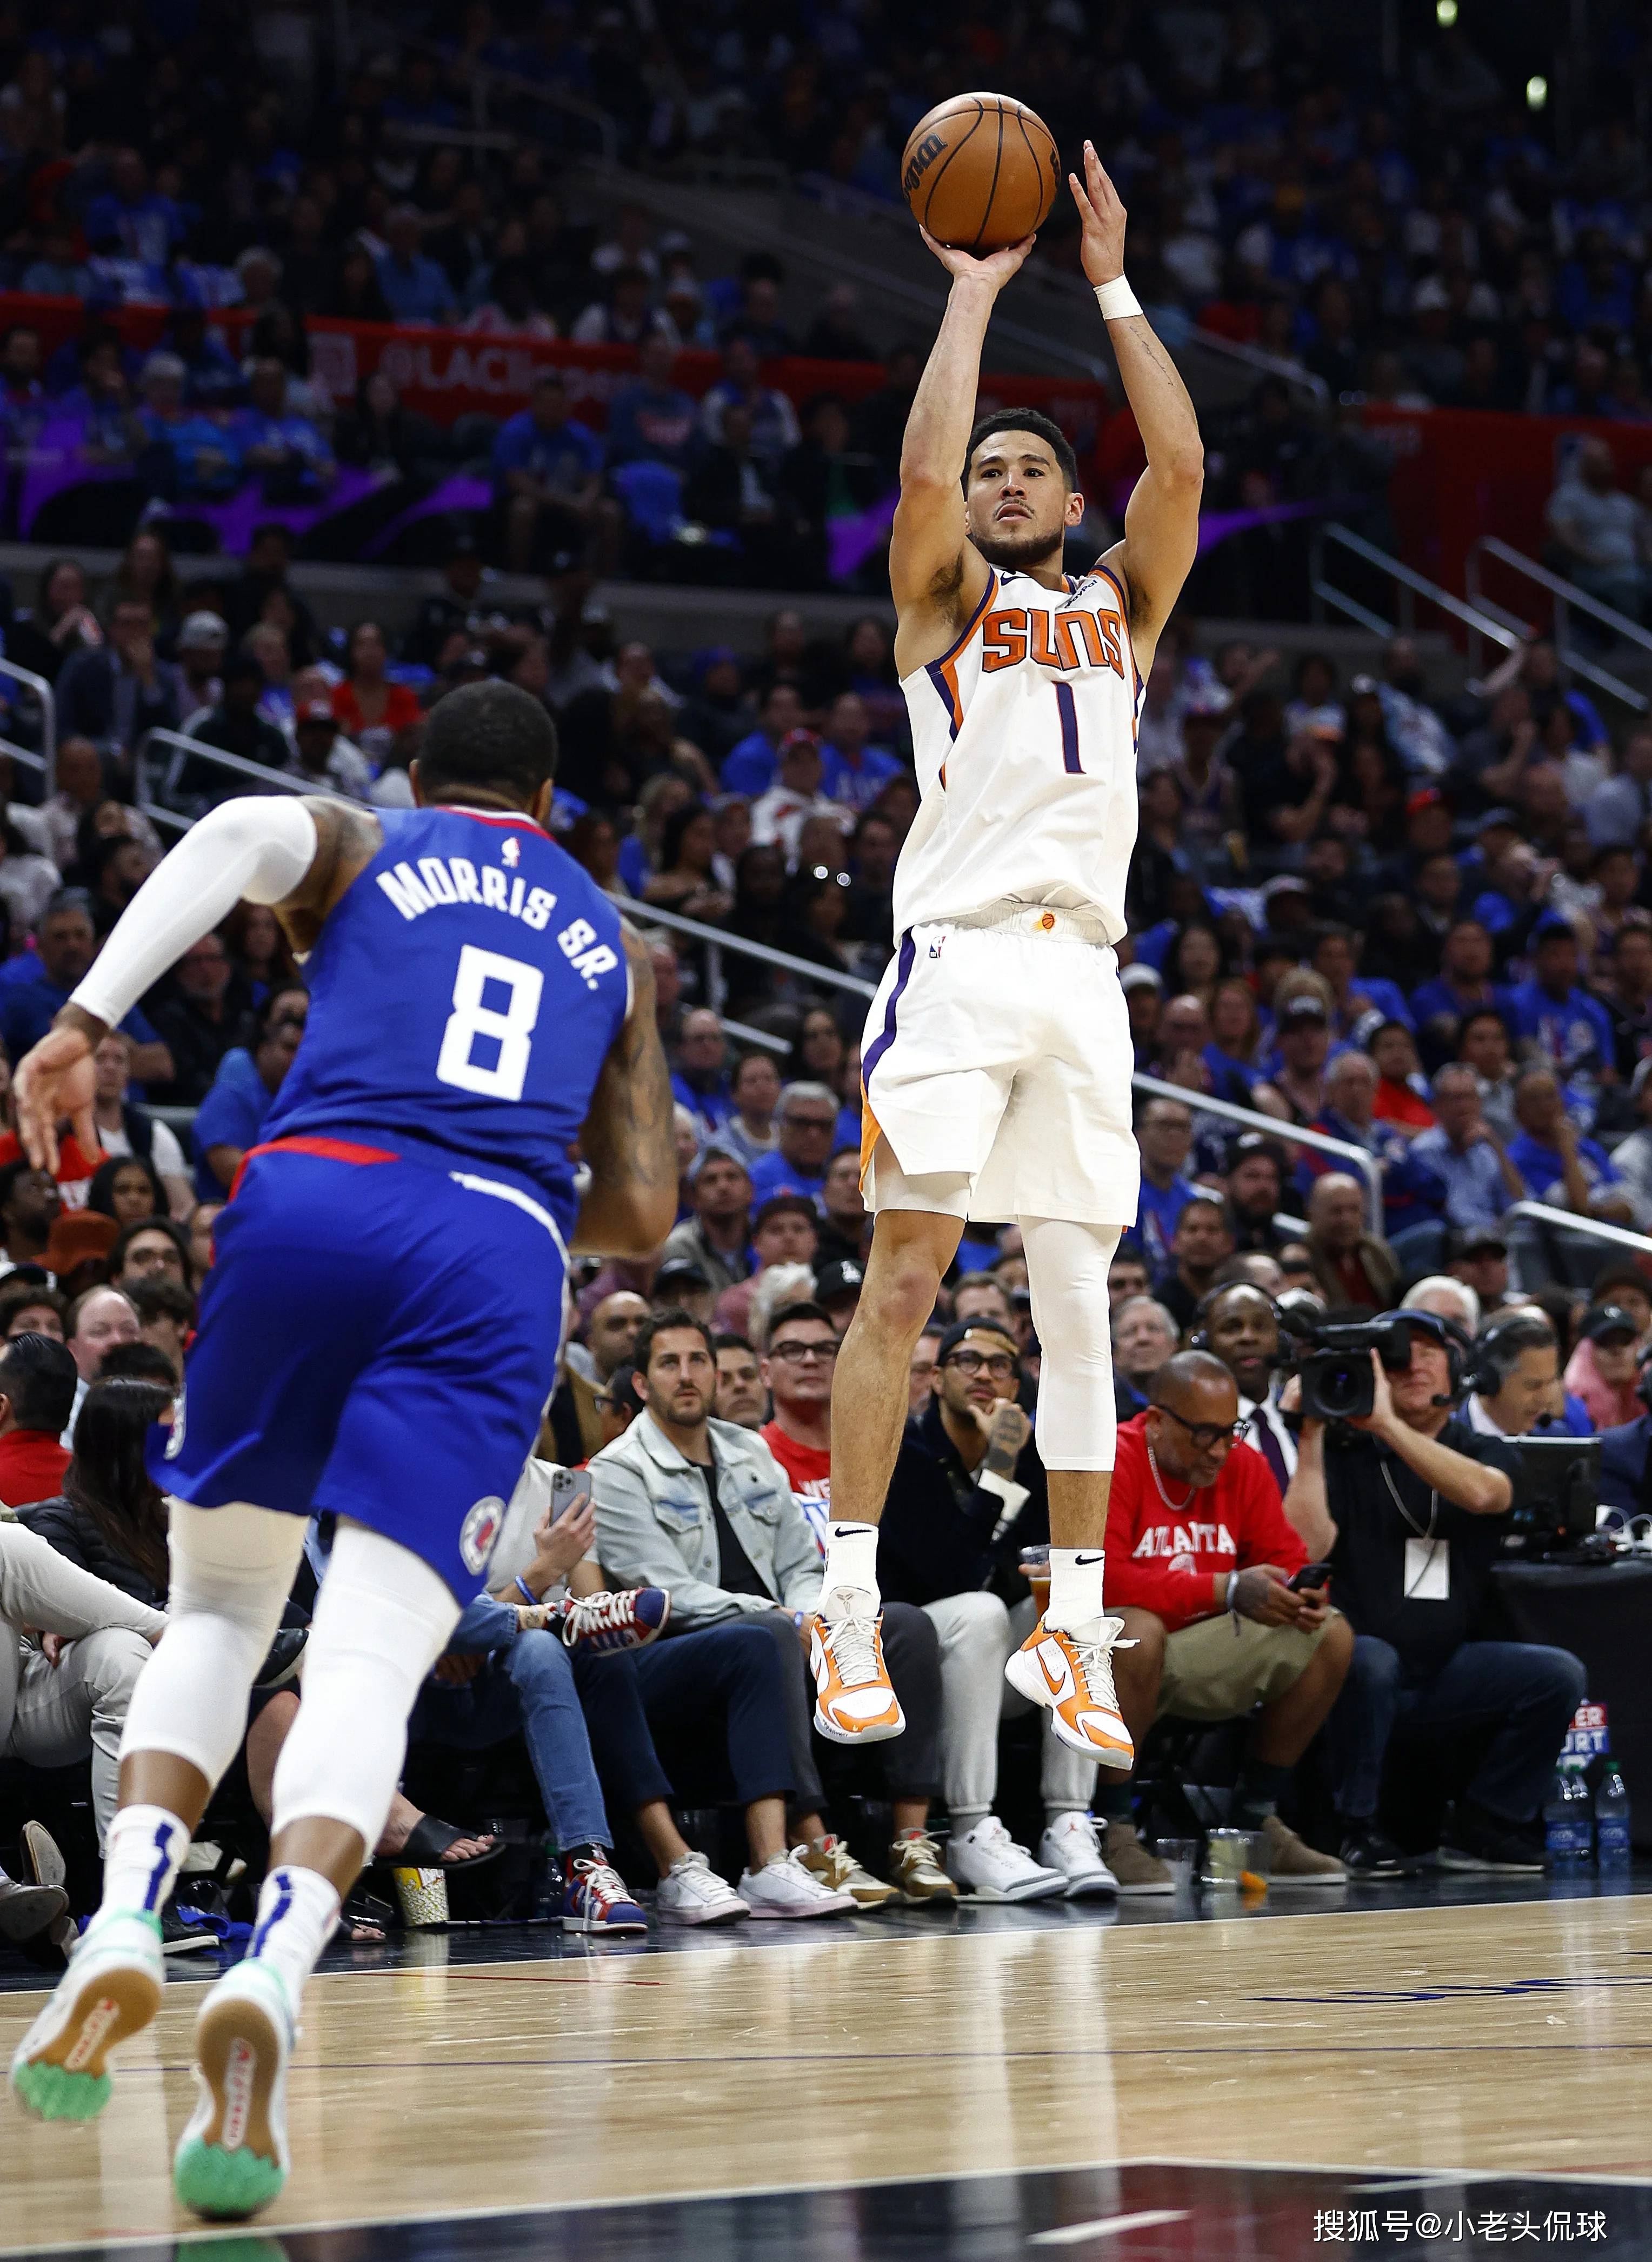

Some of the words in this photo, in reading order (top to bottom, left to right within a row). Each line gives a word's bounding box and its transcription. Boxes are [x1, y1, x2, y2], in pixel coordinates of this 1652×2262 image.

[982, 608, 1125, 680] SUNS
[1051, 680, 1087, 774] 1
[376, 857, 557, 931] MORRIS
[557, 917, 618, 990] SR.
[436, 943, 545, 1102] 8
